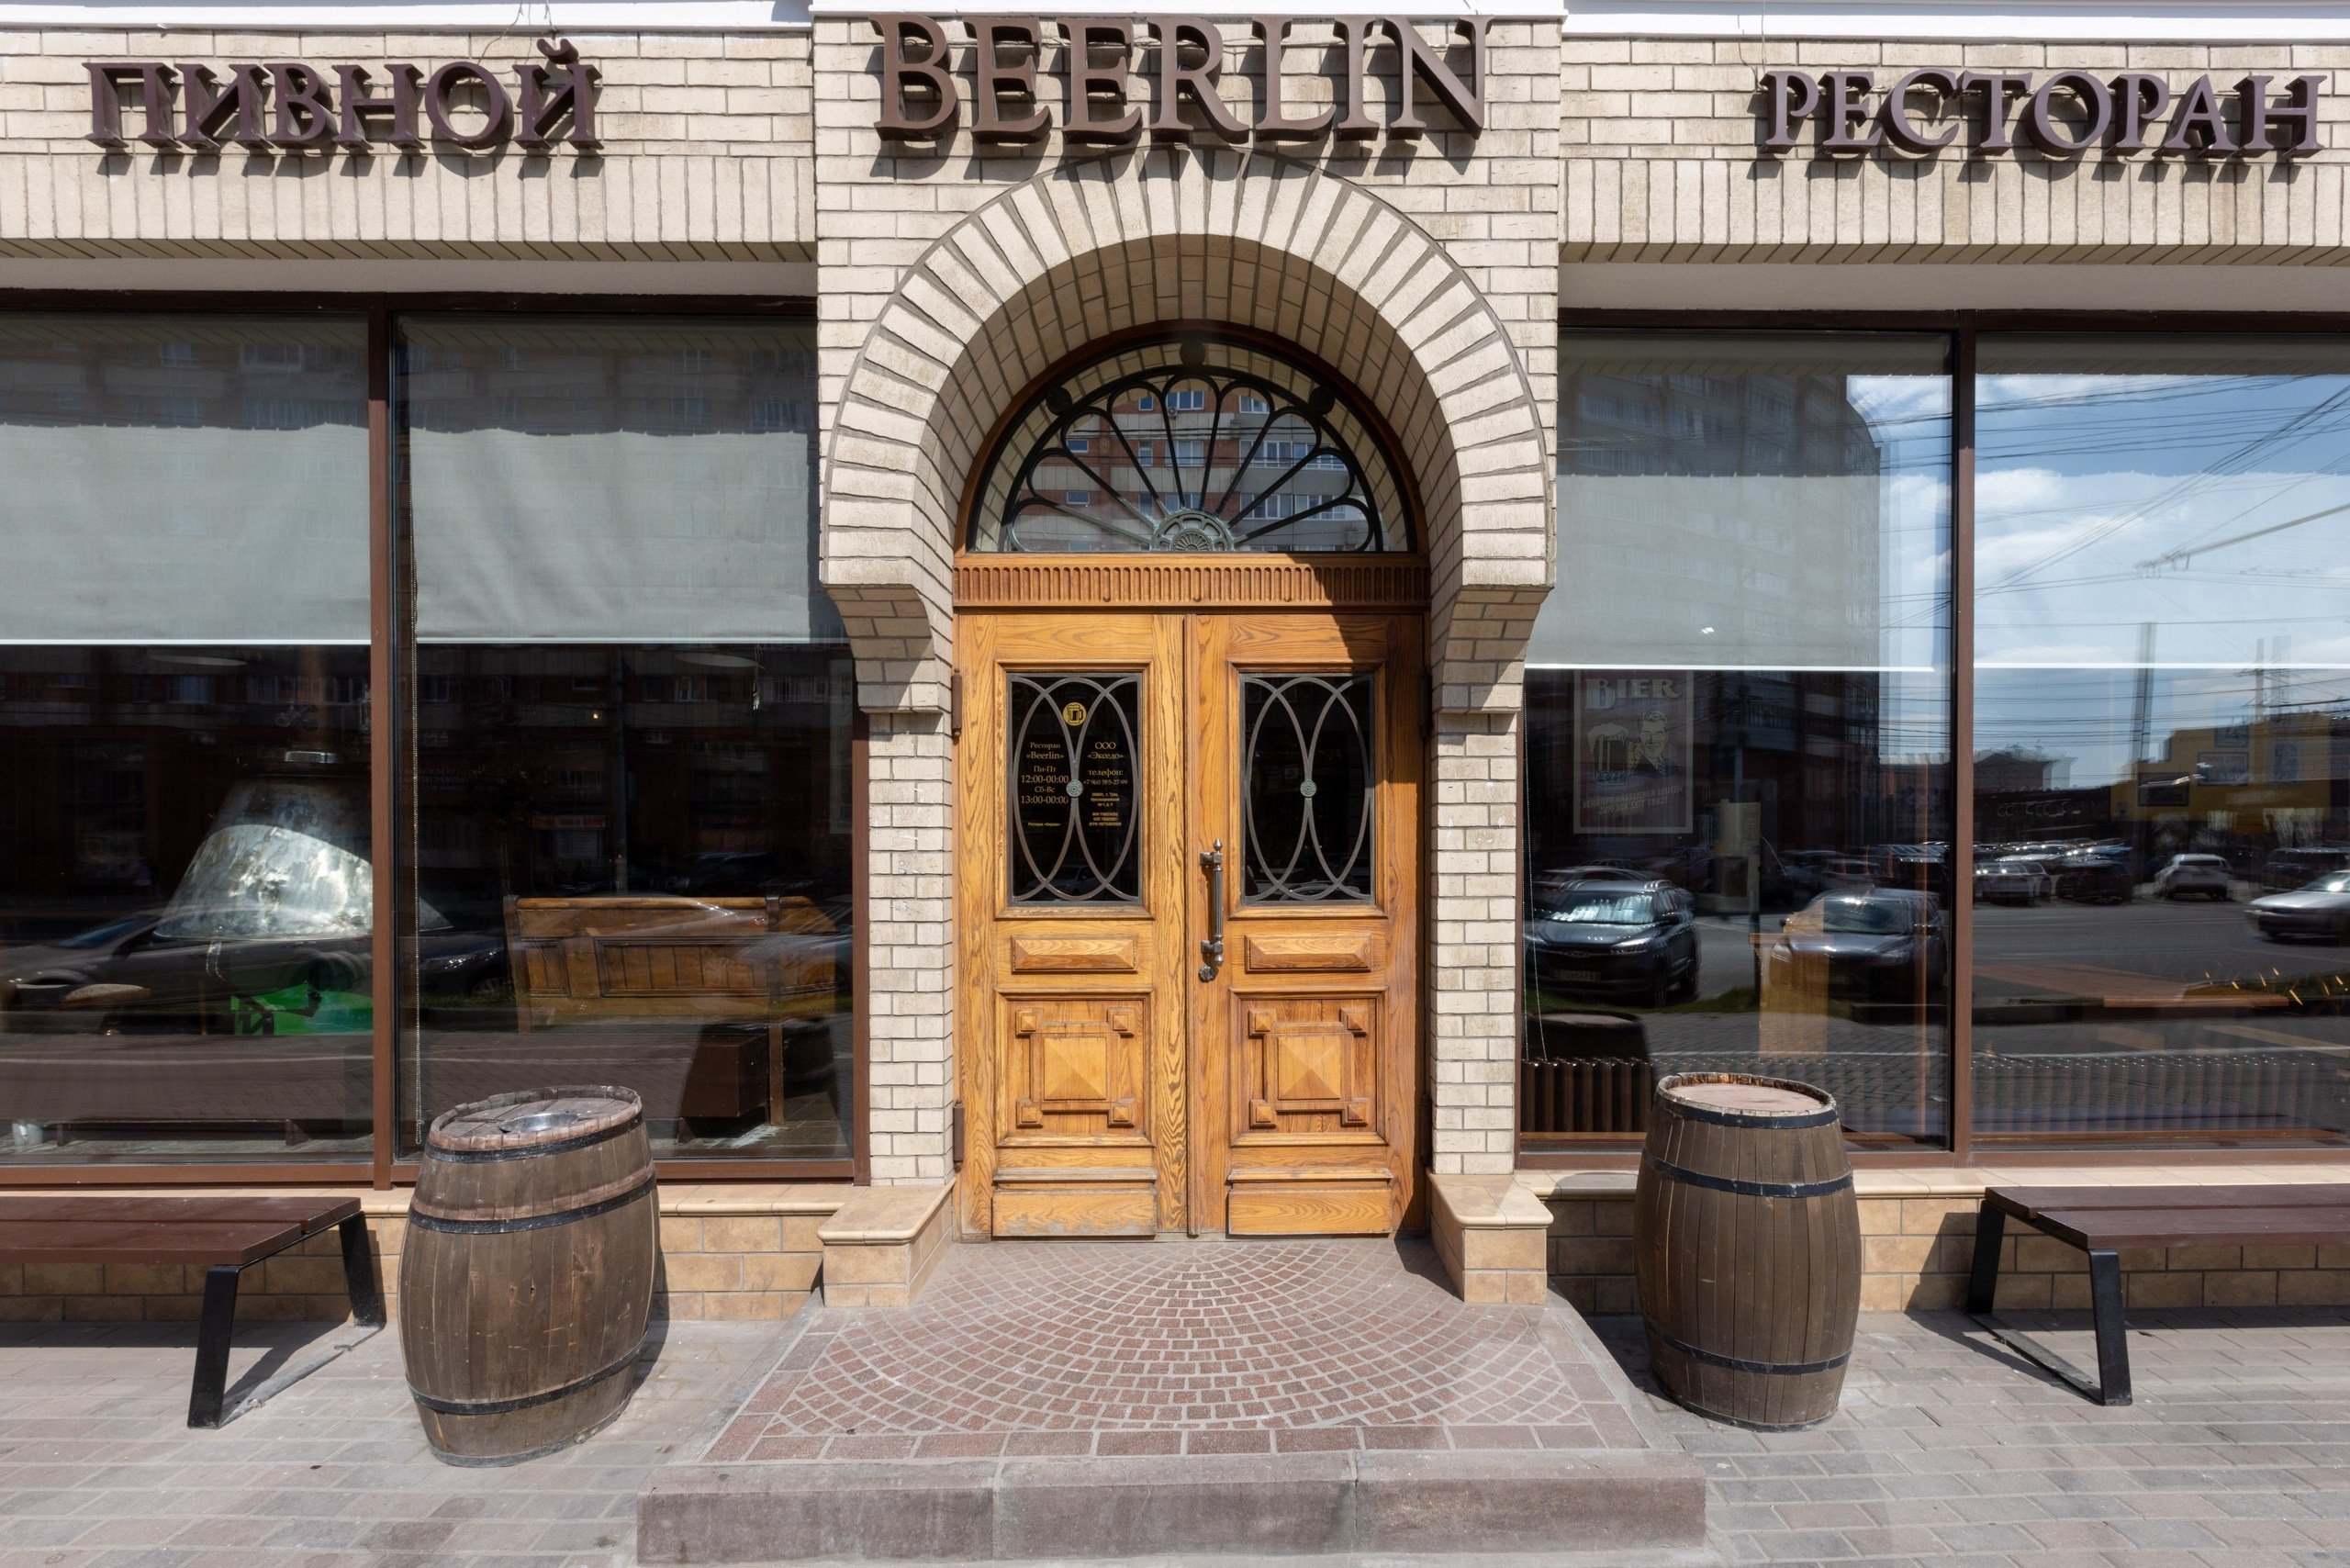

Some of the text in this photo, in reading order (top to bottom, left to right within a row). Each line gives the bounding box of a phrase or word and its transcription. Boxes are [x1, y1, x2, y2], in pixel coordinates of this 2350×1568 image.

[869, 14, 1494, 145] BEERLIN
[82, 38, 605, 151] ПИВНОЙ
[1759, 66, 2329, 159] РЕСТОРАН
[1584, 678, 1682, 710] BIER
[1030, 742, 1060, 750] Ресторан
[1026, 751, 1064, 759] «Beerlin»
[1088, 752, 1124, 760] «Экседо»
[1088, 768, 1124, 778] телефон:
[1021, 775, 1069, 783] 12:00-00:00
[1021, 795, 1069, 804] 13:00-00:00
